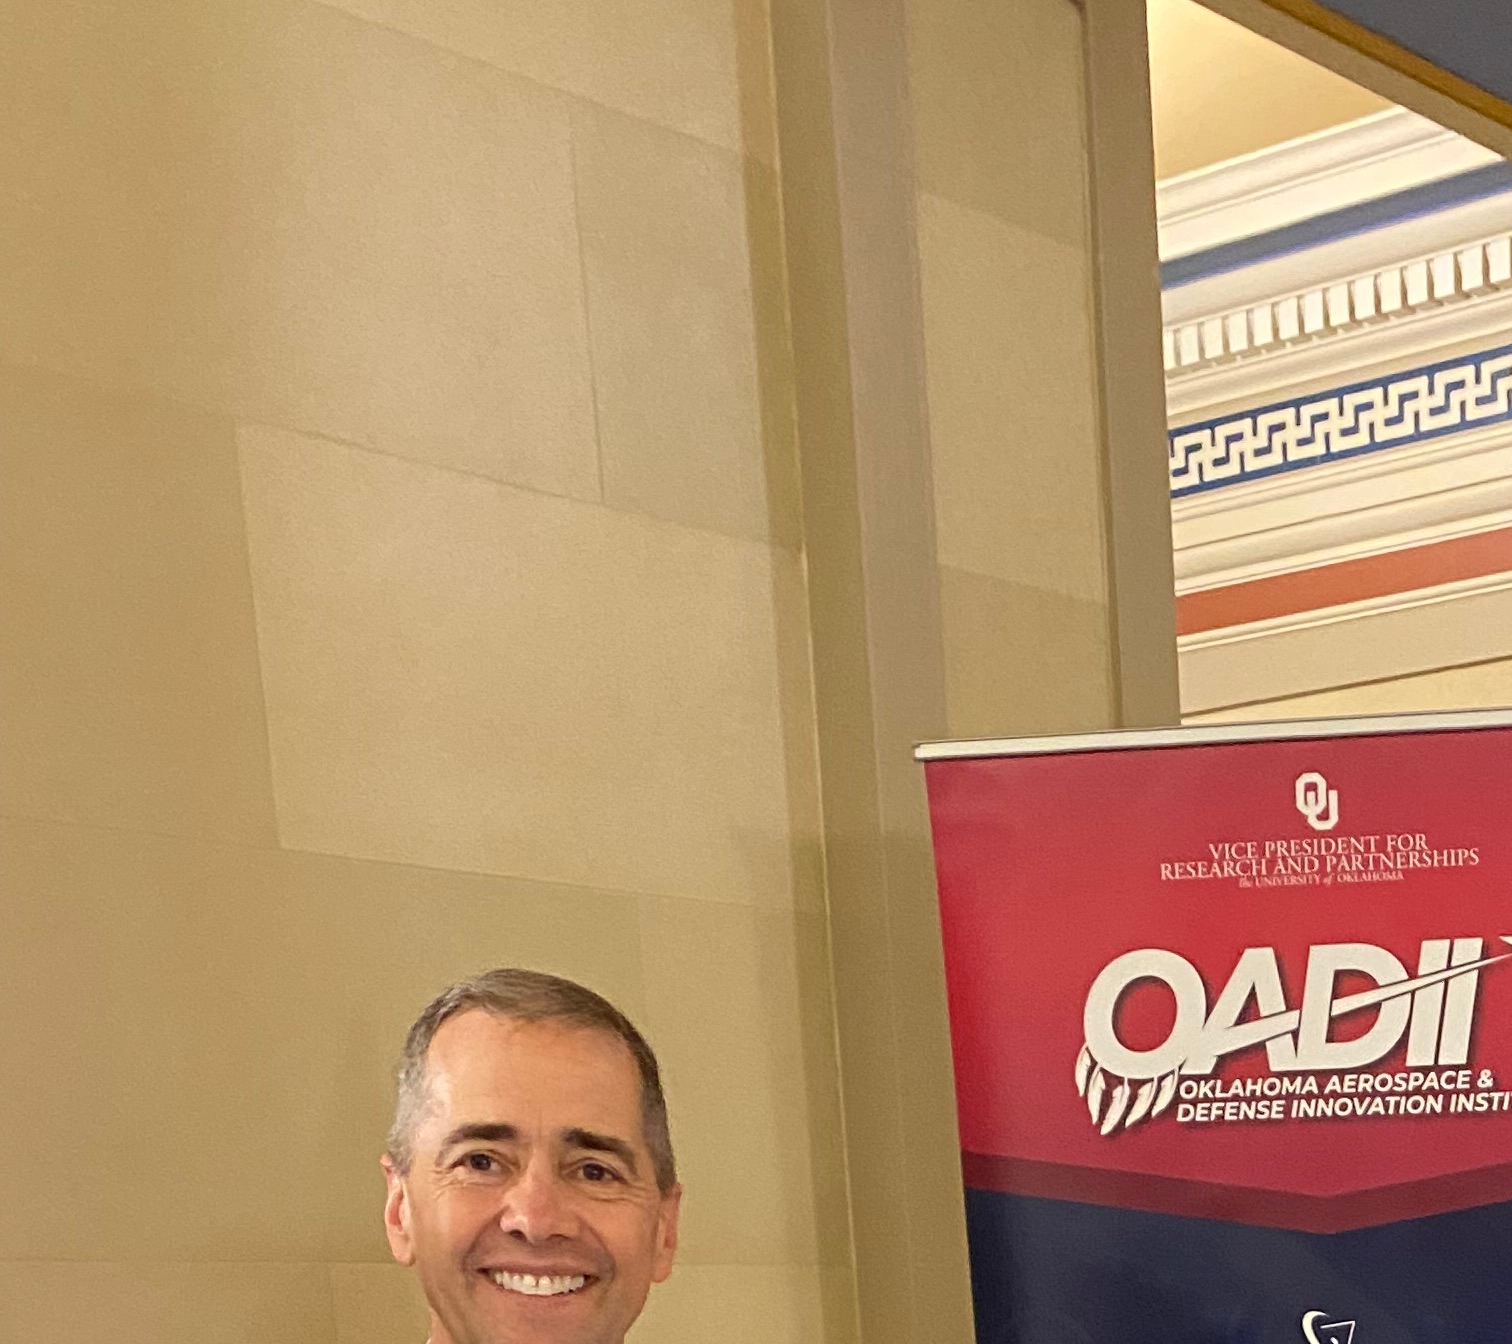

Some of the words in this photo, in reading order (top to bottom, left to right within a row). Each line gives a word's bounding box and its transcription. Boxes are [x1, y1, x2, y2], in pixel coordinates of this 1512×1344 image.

[1296, 772, 1339, 831] OU
[1209, 842, 1258, 861] VICE
[1265, 834, 1381, 860] PRESIDENT
[1387, 833, 1429, 854] FOR
[1160, 859, 1267, 881] RESEARCH
[1274, 855, 1320, 876] AND
[1326, 847, 1480, 873] PARTNERSHIPS
[1255, 873, 1321, 887] UNIVERSITY
[1083, 937, 1484, 1078] OADII
[1180, 1075, 1318, 1100] OKLAHOMA
[1324, 1069, 1473, 1095] AEROSPACE
[1477, 1070, 1495, 1088] &
[1176, 1099, 1285, 1122] DEFENSE
[1291, 1093, 1444, 1118] INNOVATION
